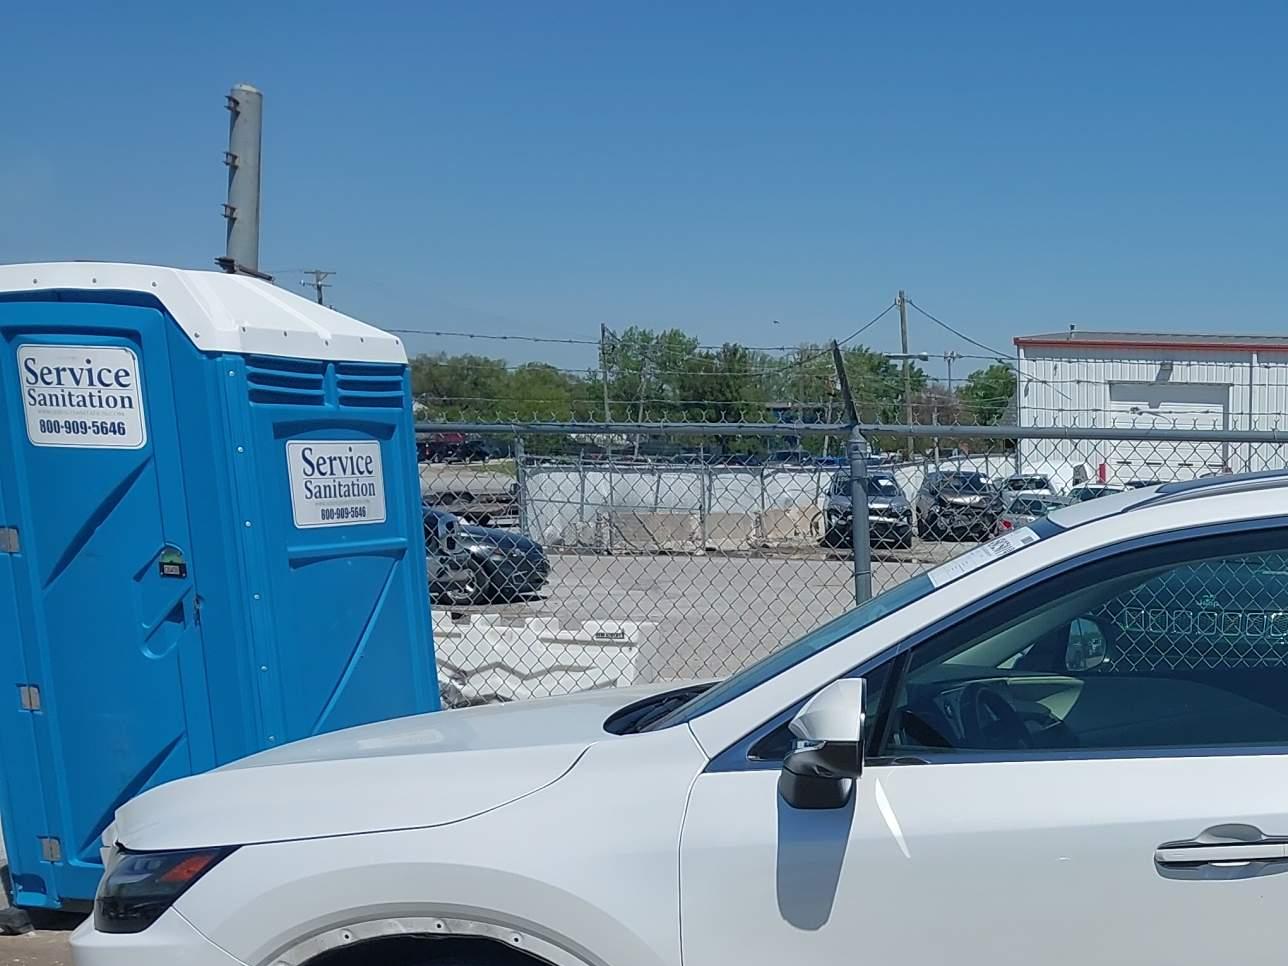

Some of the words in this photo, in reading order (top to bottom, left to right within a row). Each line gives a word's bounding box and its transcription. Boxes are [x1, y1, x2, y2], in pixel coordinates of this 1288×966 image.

[24, 357, 131, 387] Service
[27, 388, 134, 409] Sanitation
[301, 446, 374, 477] Service
[304, 479, 376, 500] Sanitation
